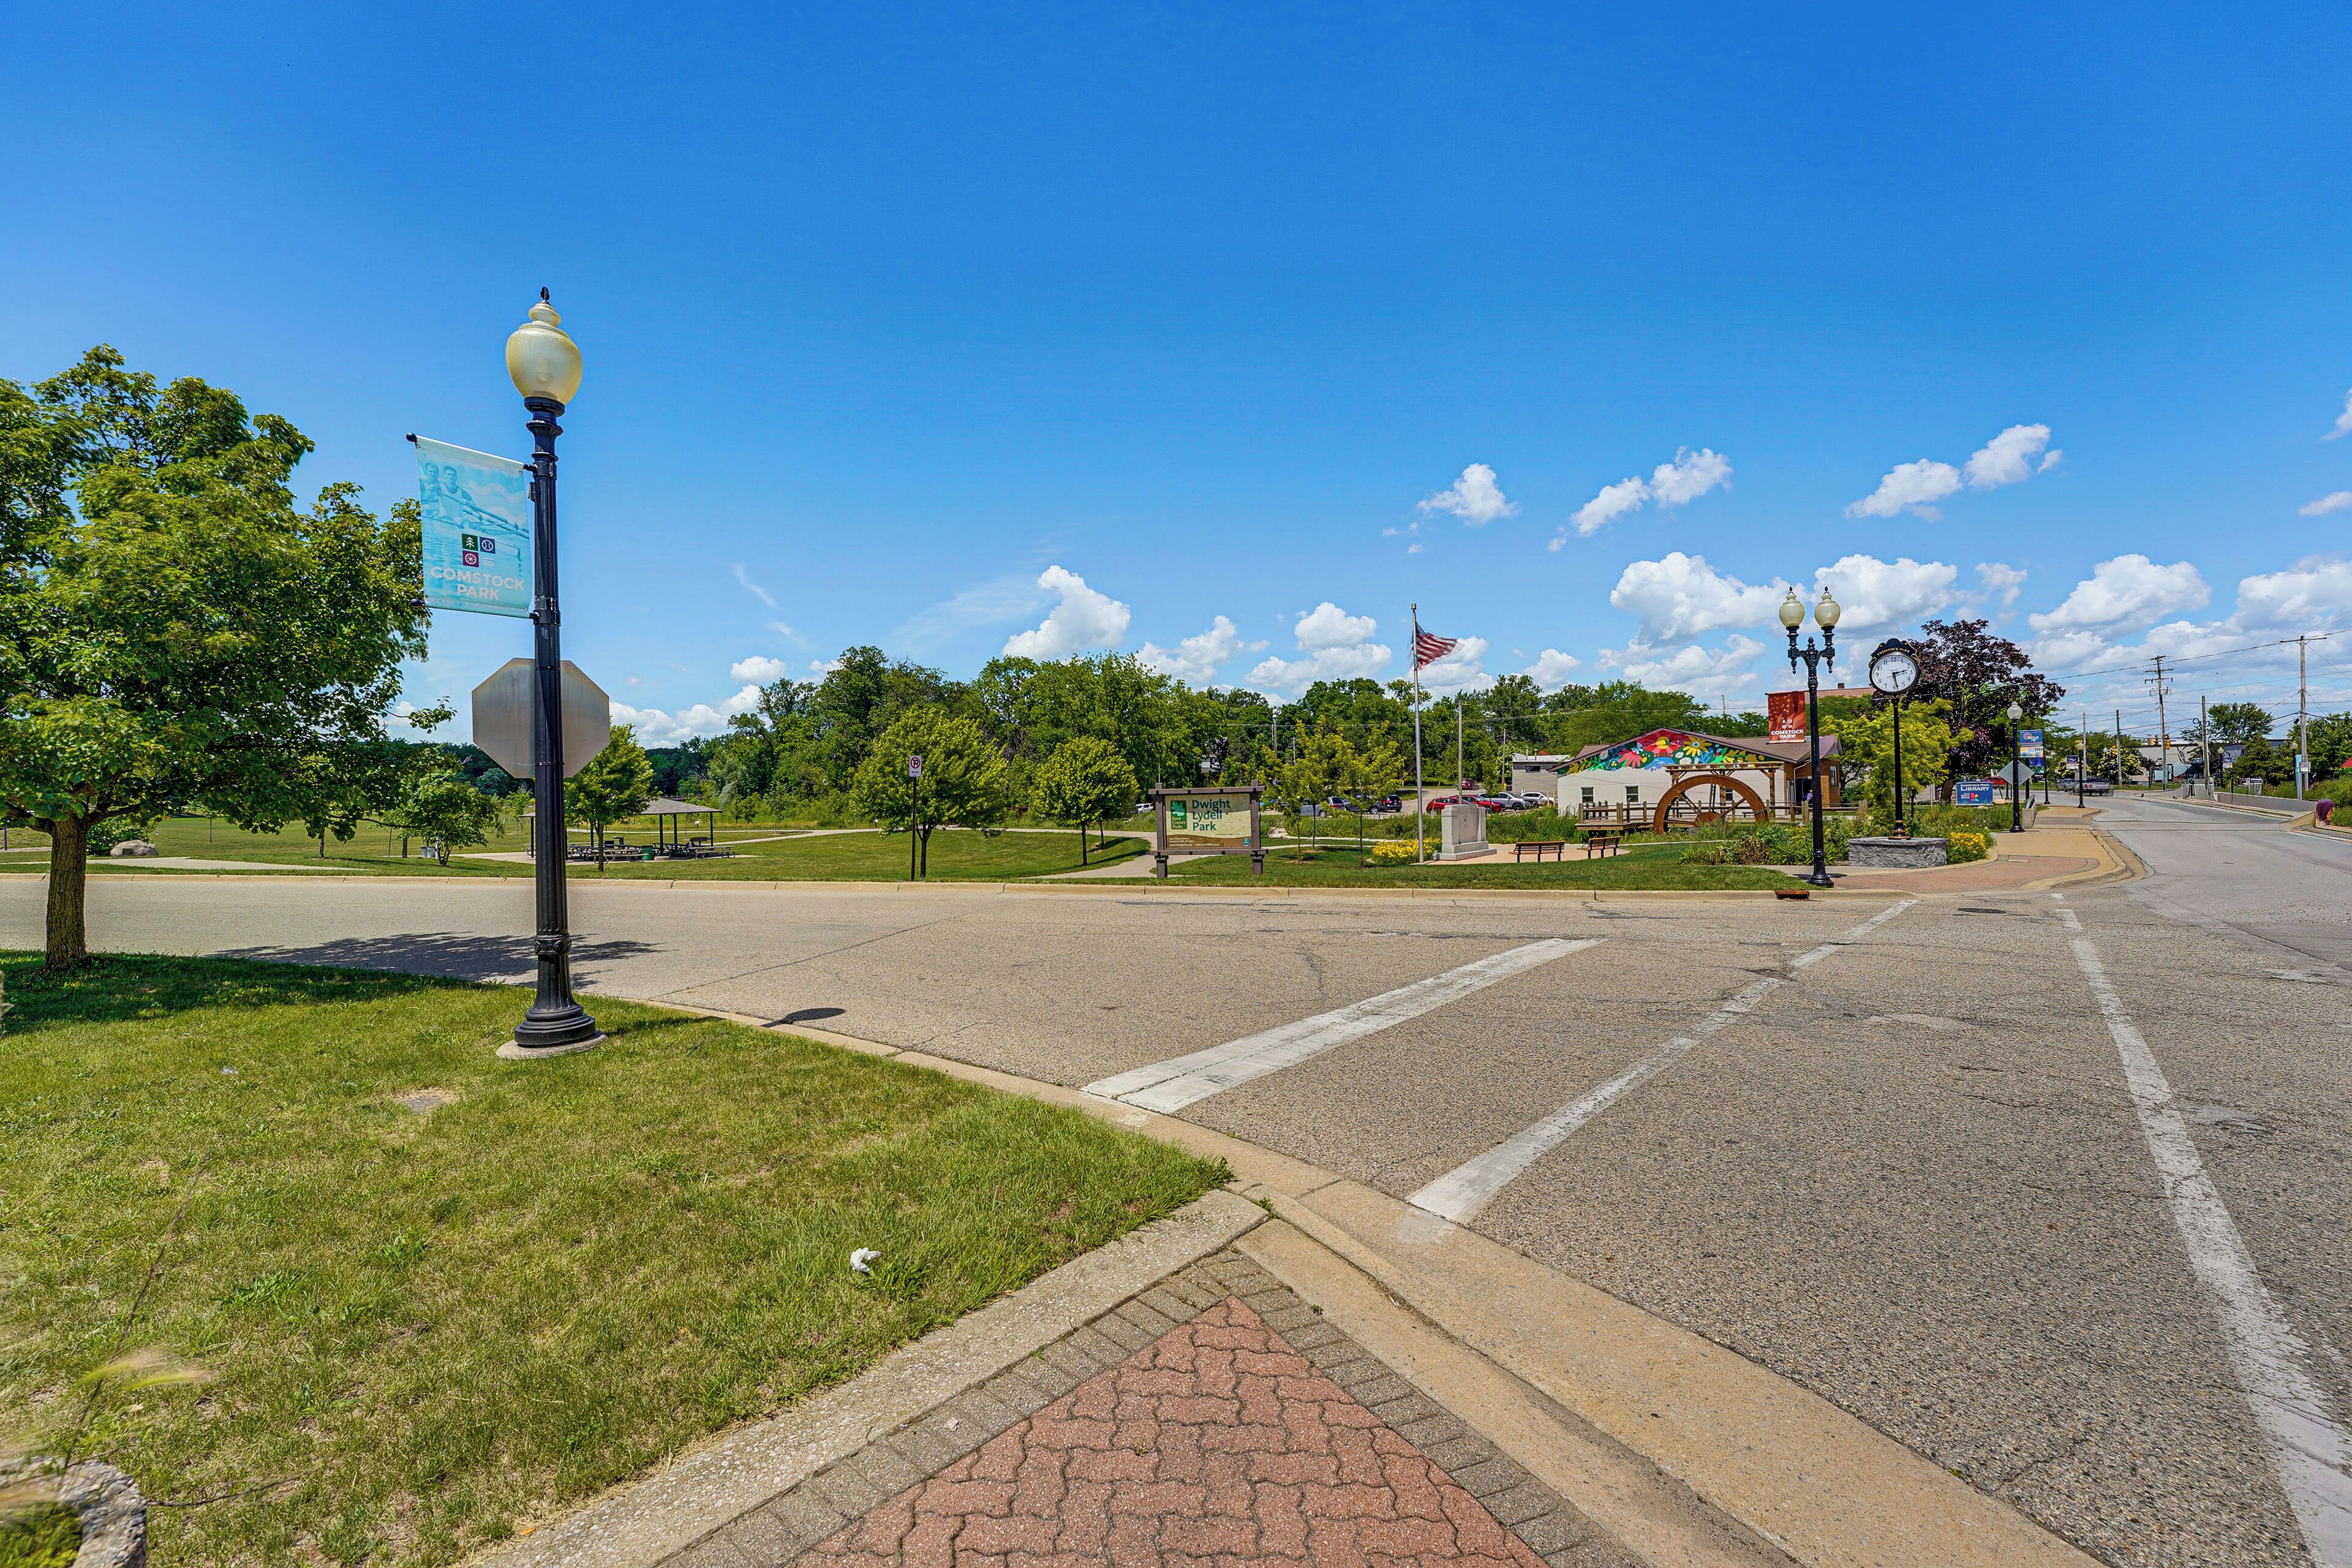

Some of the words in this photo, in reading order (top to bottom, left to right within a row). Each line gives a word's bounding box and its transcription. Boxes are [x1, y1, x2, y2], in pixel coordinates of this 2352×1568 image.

[431, 566, 524, 591] COMSTOCK
[456, 584, 500, 600] PARK
[1192, 799, 1231, 812] Dwight
[1193, 810, 1223, 822] Lydell
[1193, 821, 1216, 831] Park
